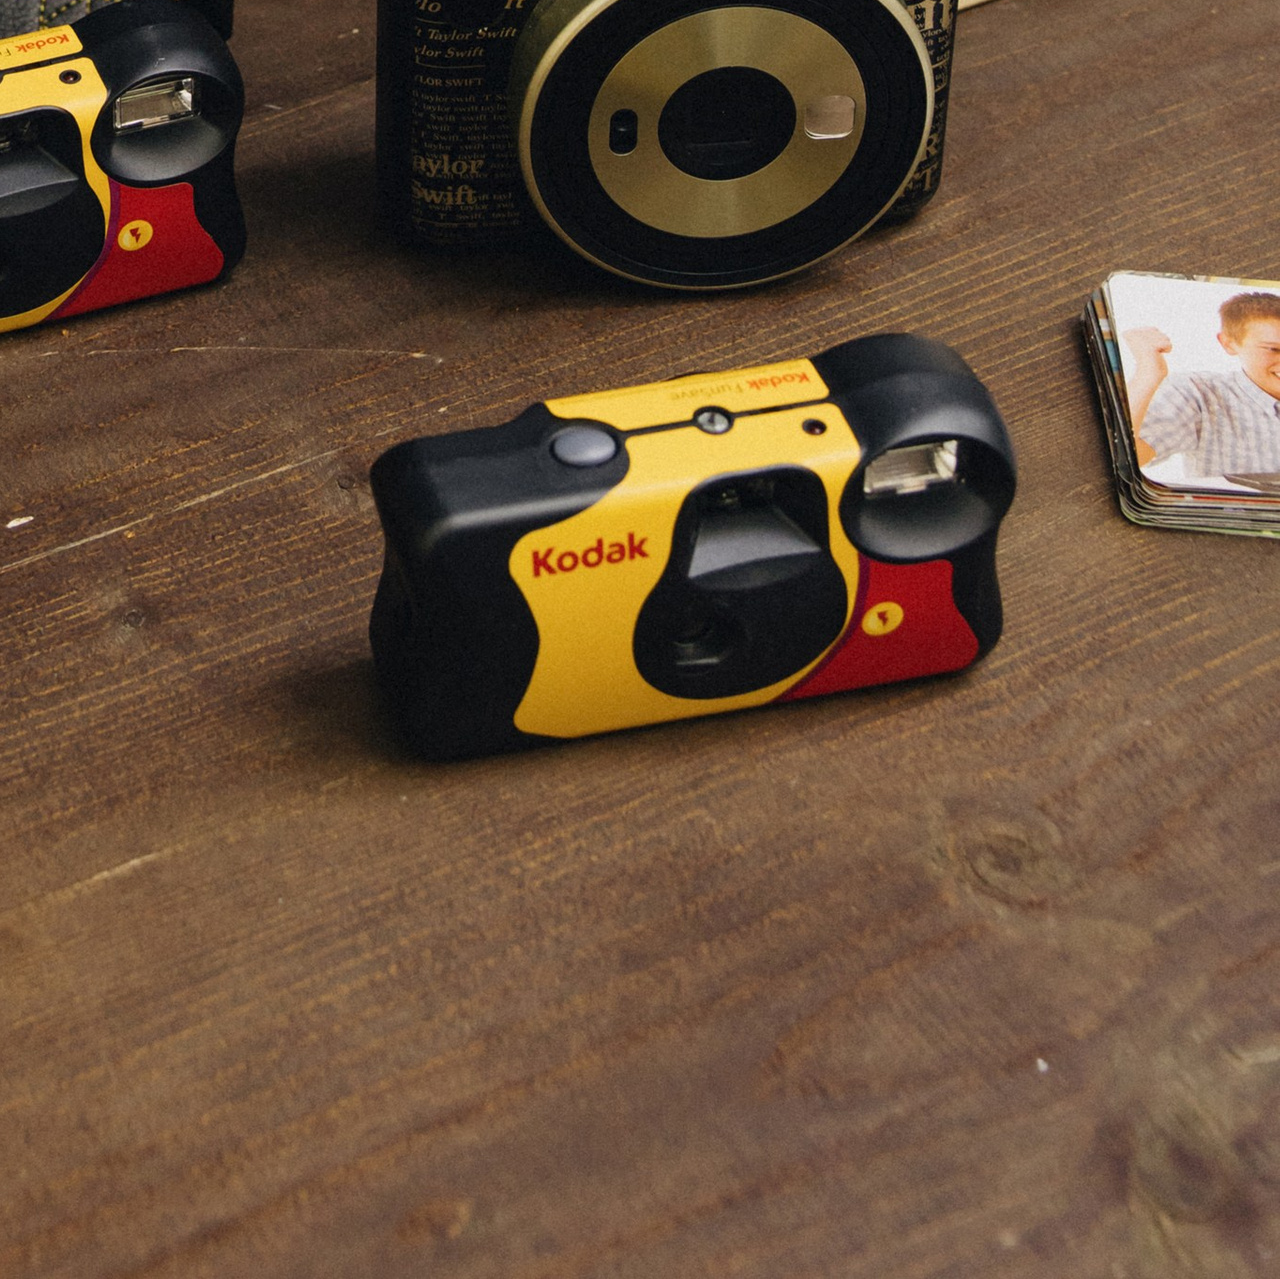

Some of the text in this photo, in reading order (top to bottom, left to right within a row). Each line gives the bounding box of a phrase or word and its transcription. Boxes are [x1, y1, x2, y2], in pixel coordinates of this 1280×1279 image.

[427, 27, 473, 42] Taylor
[476, 26, 518, 41] Swift
[17, 33, 70, 54] Kodak
[444, 45, 485, 59] Swift
[445, 77, 484, 87] SWIFT
[747, 372, 811, 391] Kodak
[532, 531, 650, 578] Kodak
